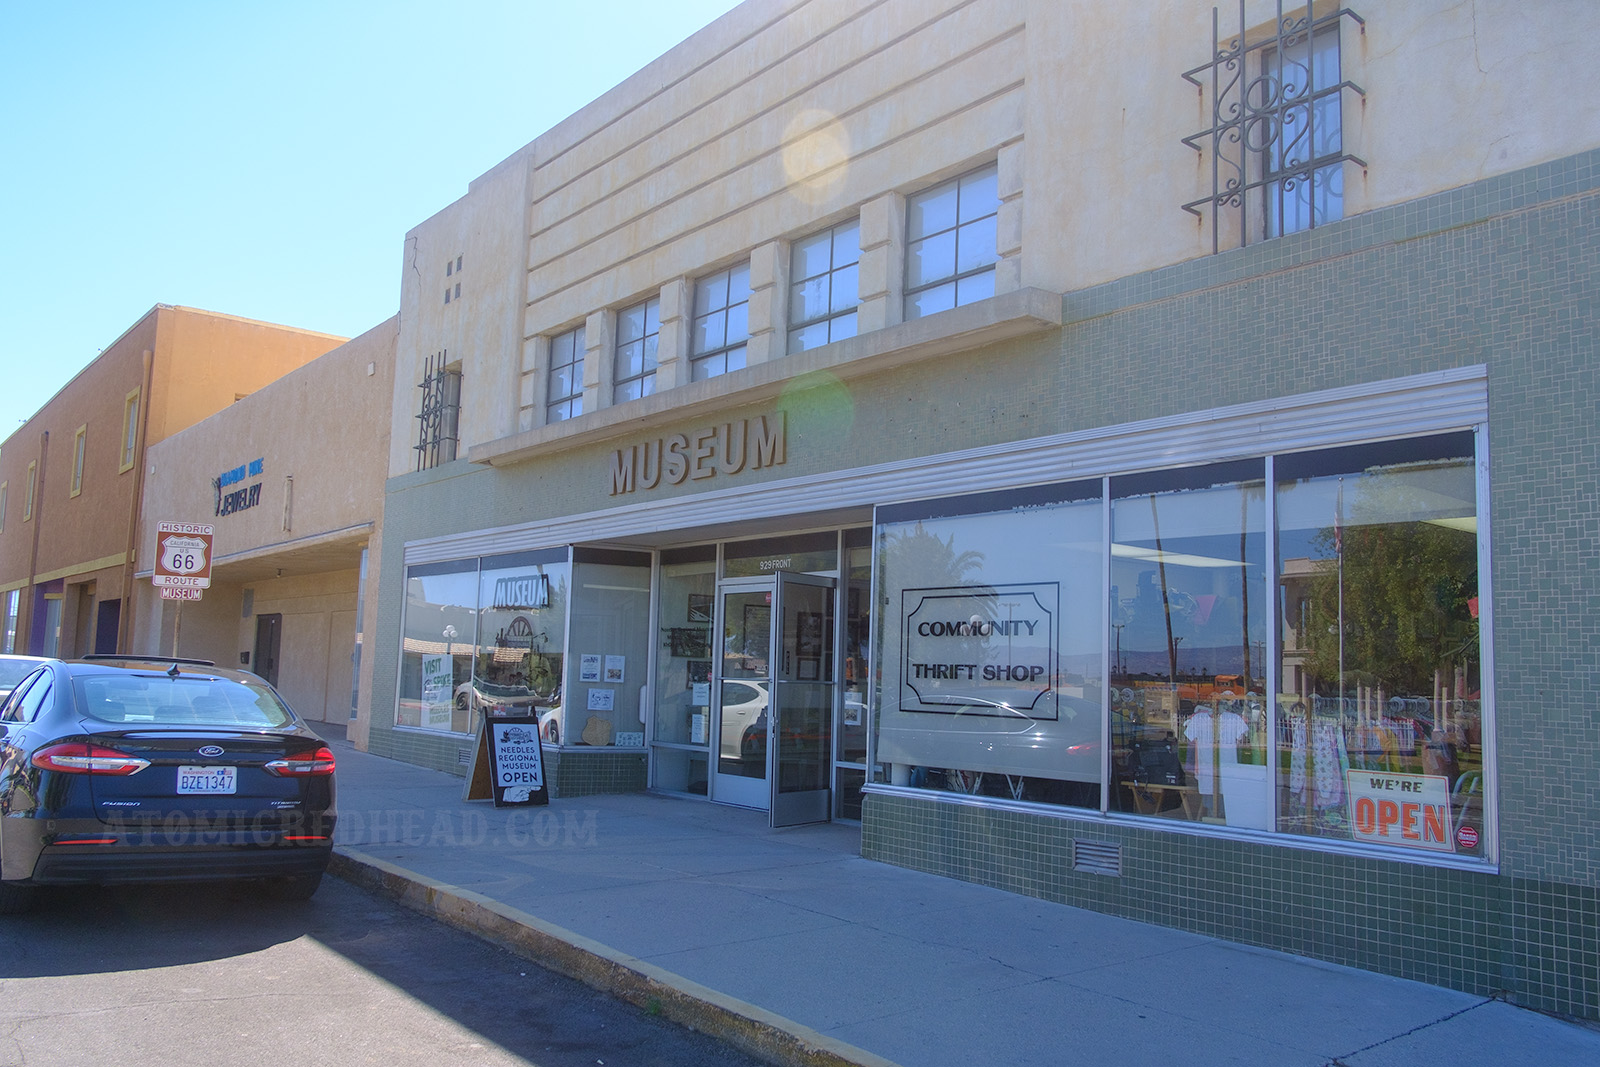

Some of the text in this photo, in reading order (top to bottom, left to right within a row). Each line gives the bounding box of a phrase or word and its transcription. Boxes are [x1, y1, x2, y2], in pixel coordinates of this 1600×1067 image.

[609, 410, 787, 496] MUSEUM
[220, 482, 263, 517] JEWELRY
[161, 524, 210, 534] HISTORIC
[173, 554, 194, 570] 66
[759, 558, 792, 570] 929 FRONT
[164, 576, 199, 586] ROUTE
[162, 587, 201, 600] MUSEUM
[494, 575, 549, 607] MUSEUM
[917, 620, 1039, 637] COMMUNITY
[424, 657, 442, 675] VISIT
[912, 663, 1045, 682] THRIFT SHOP
[500, 746, 535, 754] NEEDLES
[498, 754, 539, 762] REGIONAL
[502, 762, 537, 770] MUSEUM
[181, 775, 233, 790] BZE1347
[502, 772, 538, 783] OPEN
[1369, 778, 1423, 793] WE'RE
[1355, 796, 1447, 844] OPEN
